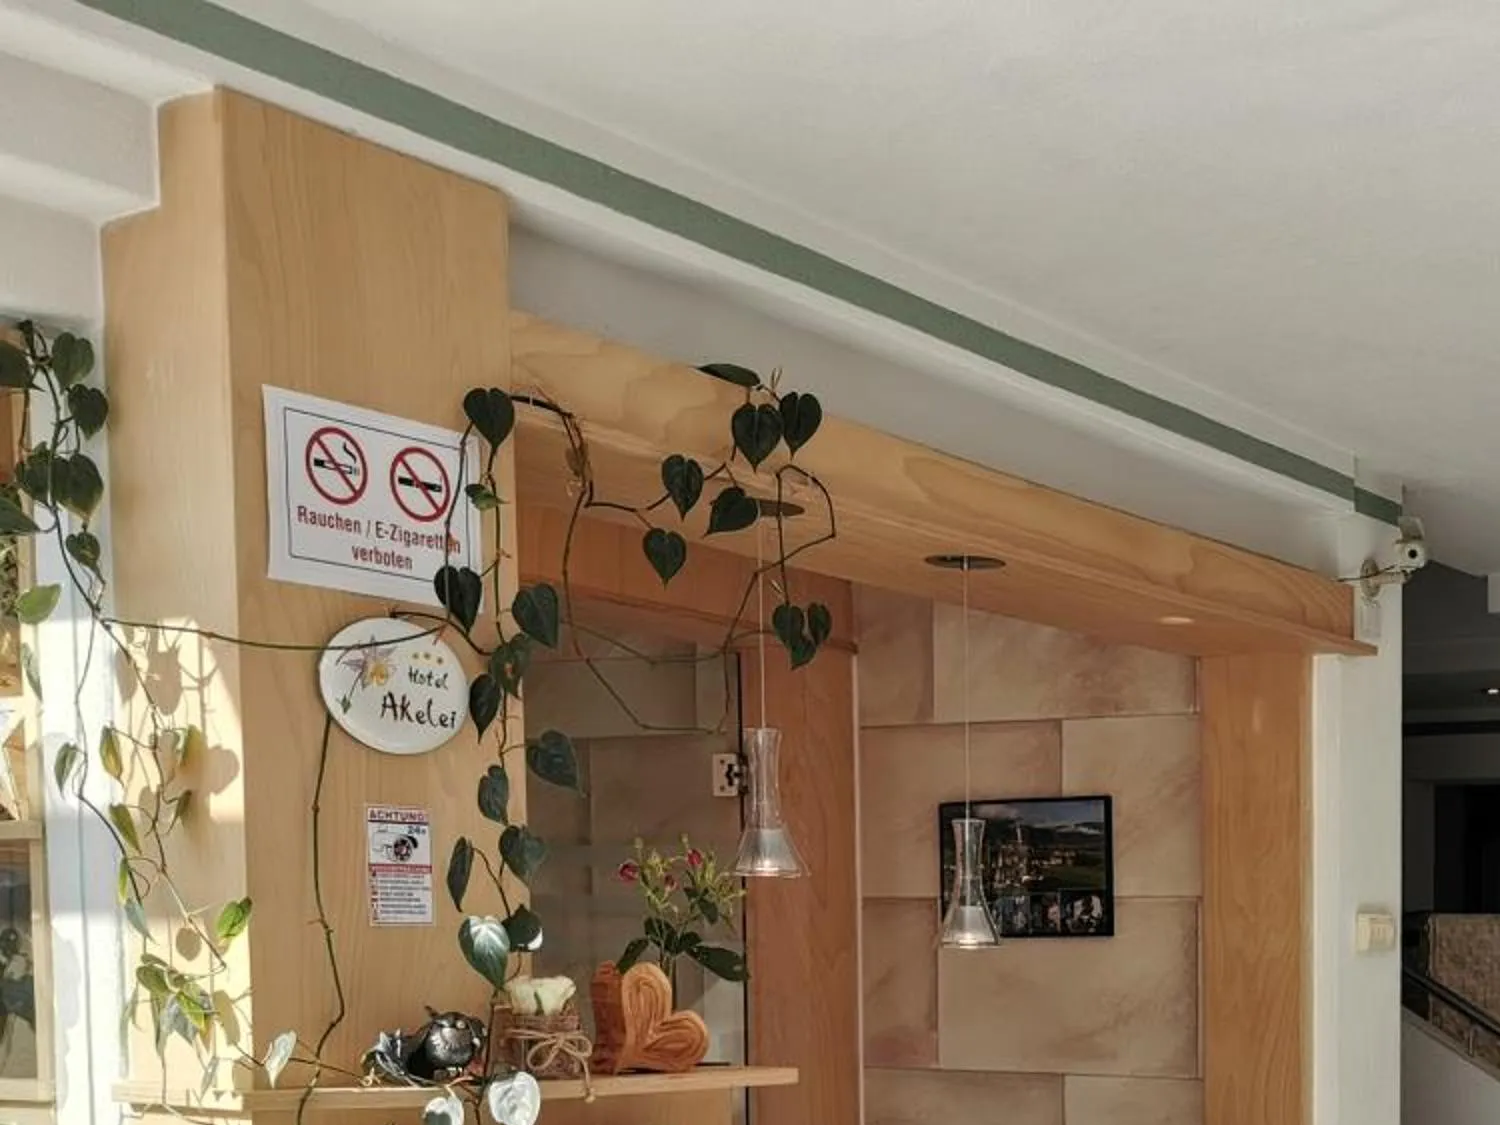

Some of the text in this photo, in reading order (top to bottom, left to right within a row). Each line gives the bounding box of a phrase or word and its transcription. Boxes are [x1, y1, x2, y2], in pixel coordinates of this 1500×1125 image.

[296, 505, 362, 535] Rauchen
[351, 545, 413, 570] verboten
[408, 666, 449, 690] Hotel
[380, 691, 457, 729] Akelei
